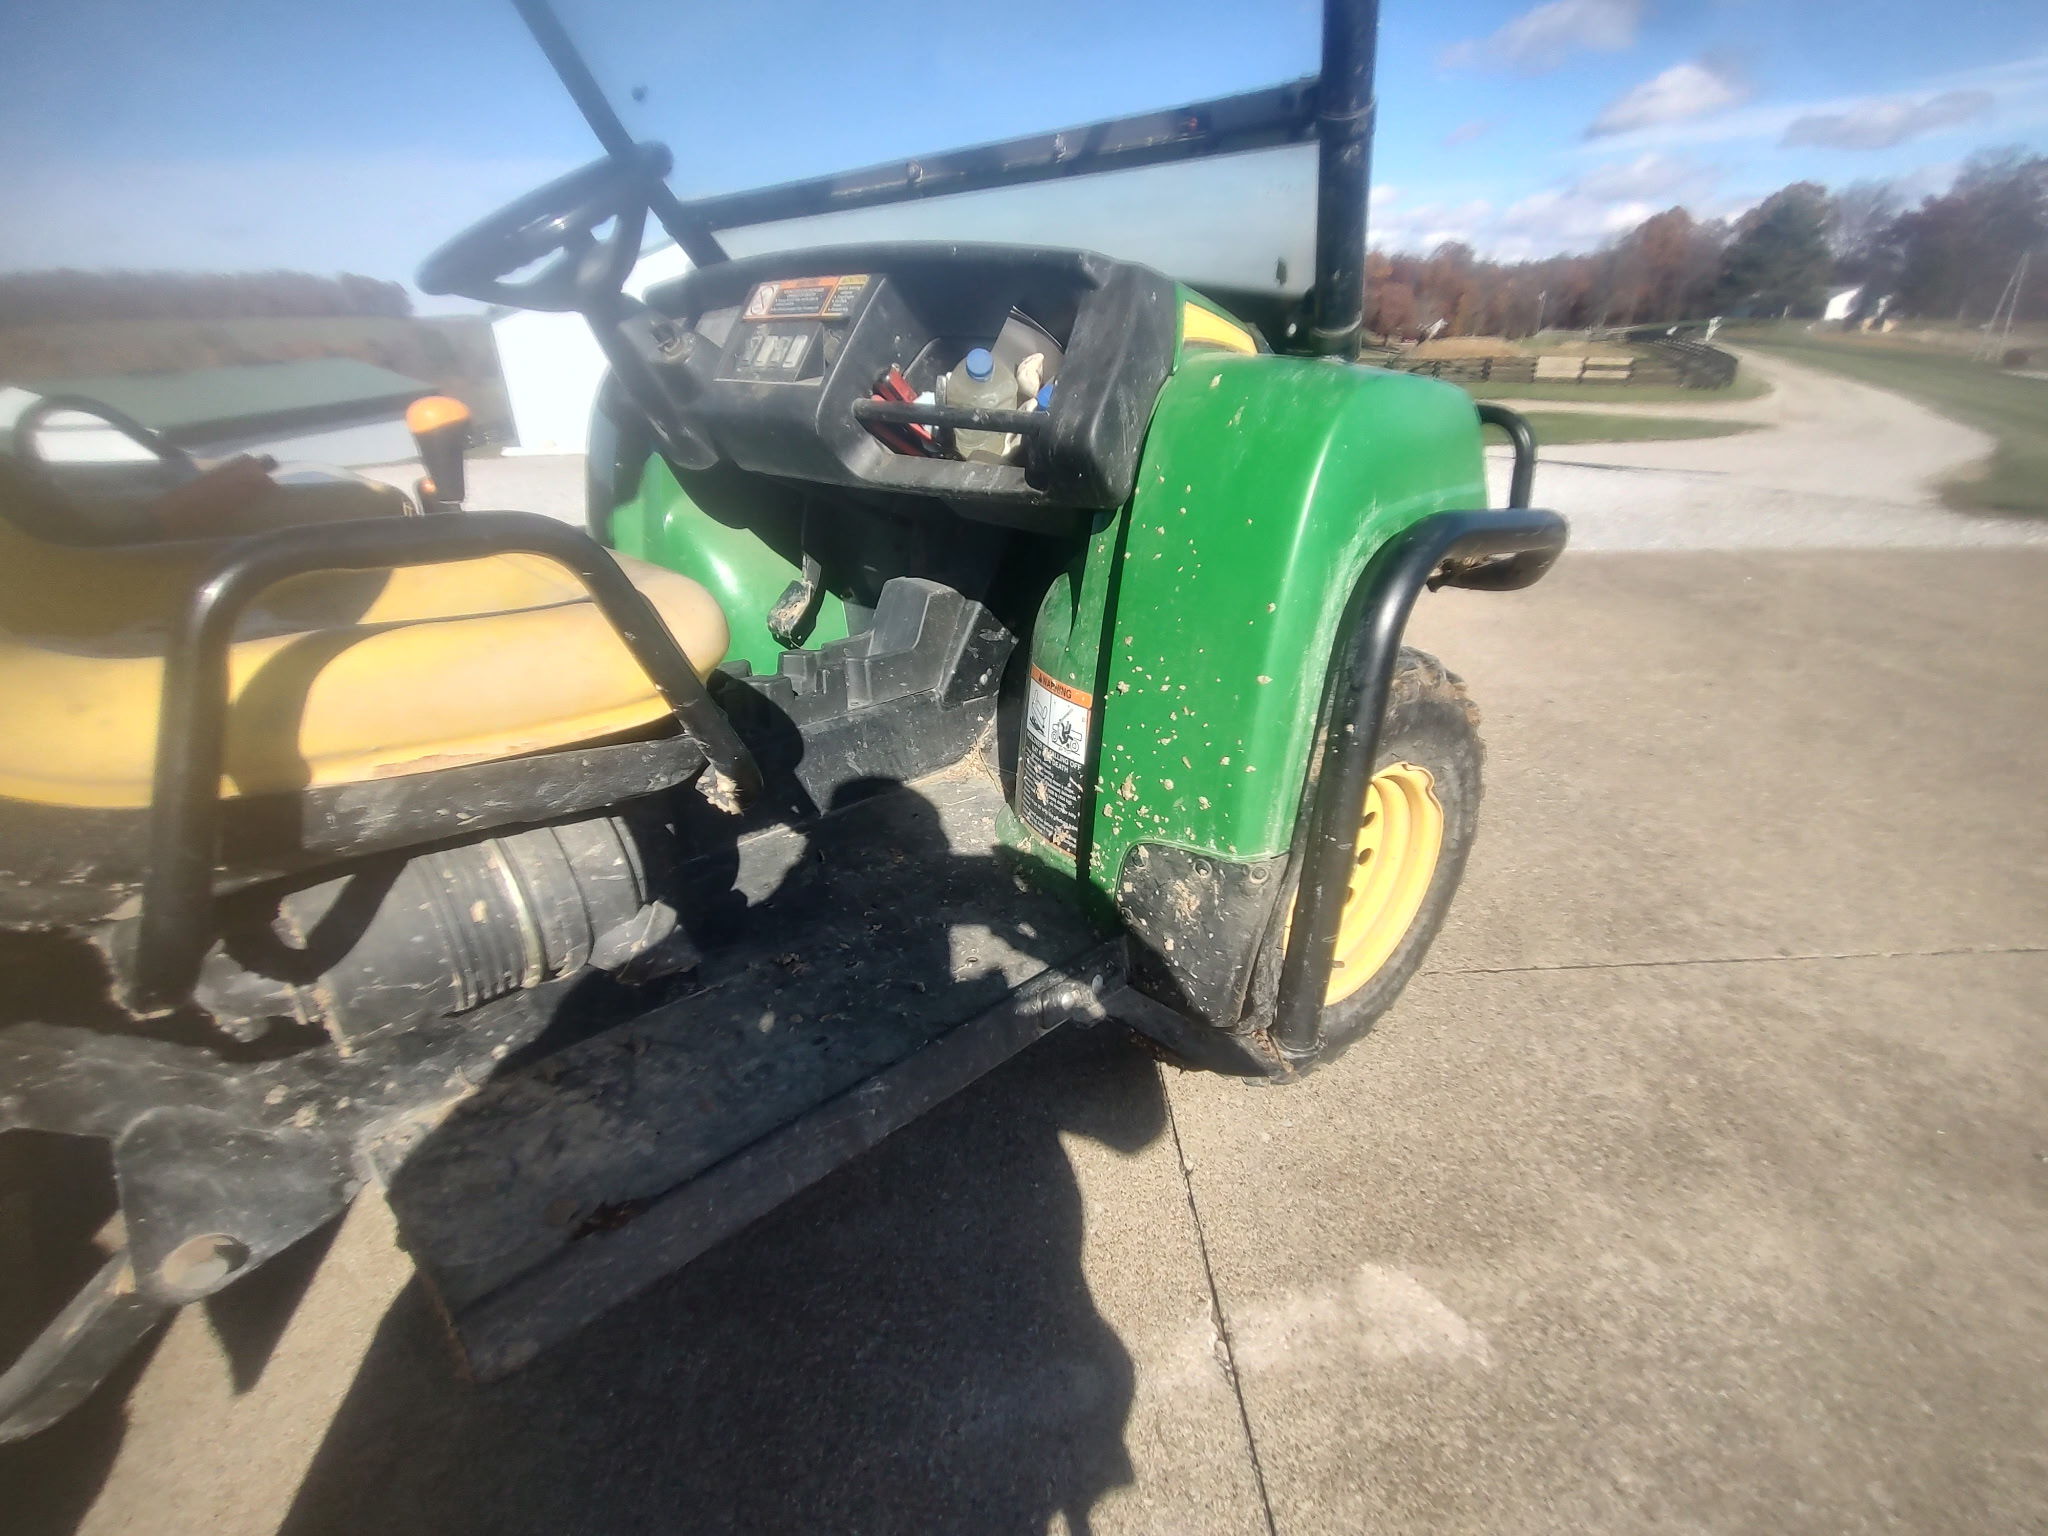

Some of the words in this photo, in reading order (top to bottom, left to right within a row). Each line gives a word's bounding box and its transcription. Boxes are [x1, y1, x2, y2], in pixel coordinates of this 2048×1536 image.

[1042, 676, 1072, 699] WARNING
[1051, 759, 1069, 774] DEATH
[1069, 760, 1083, 771] OFF
